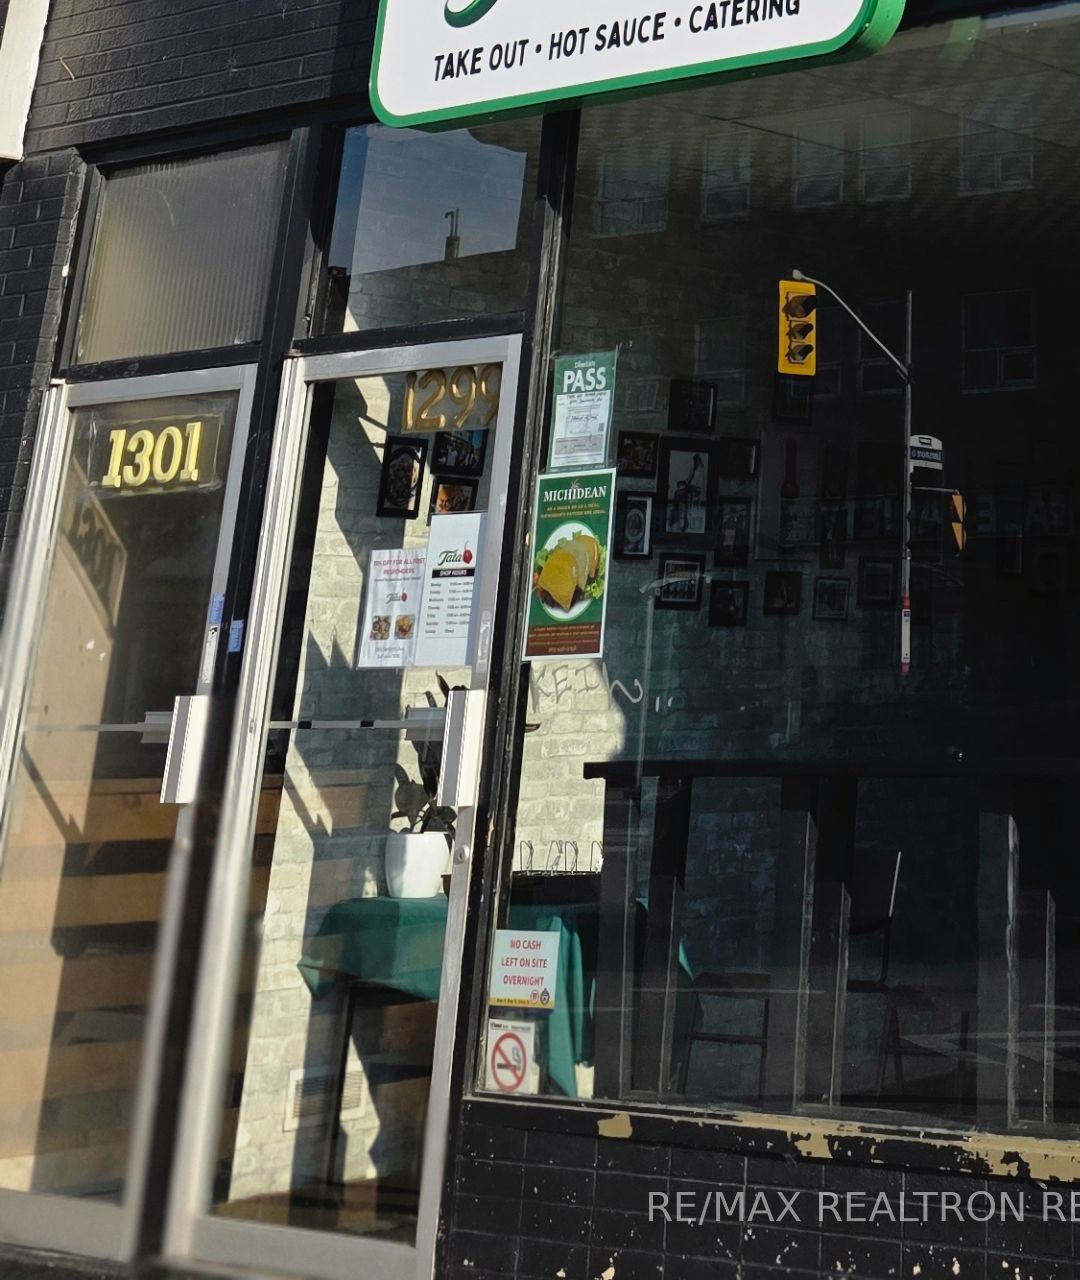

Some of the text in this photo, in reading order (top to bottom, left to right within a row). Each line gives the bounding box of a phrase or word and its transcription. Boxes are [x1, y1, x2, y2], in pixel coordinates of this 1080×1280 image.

[434, 42, 482, 82] TAKE
[489, 39, 530, 71] OUT
[548, 28, 591, 61] HOT
[594, 12, 666, 49] SAUCE
[563, 366, 607, 393] PASS
[402, 362, 502, 431] 1299
[101, 420, 203, 489] 1301
[543, 485, 607, 502] MICHIDEAN
[437, 549, 463, 566] Tata
[510, 939, 542, 951] NO CASH
[501, 957, 548, 969] LEFT ON SITE
[503, 975, 545, 987] OVERNIGHT
